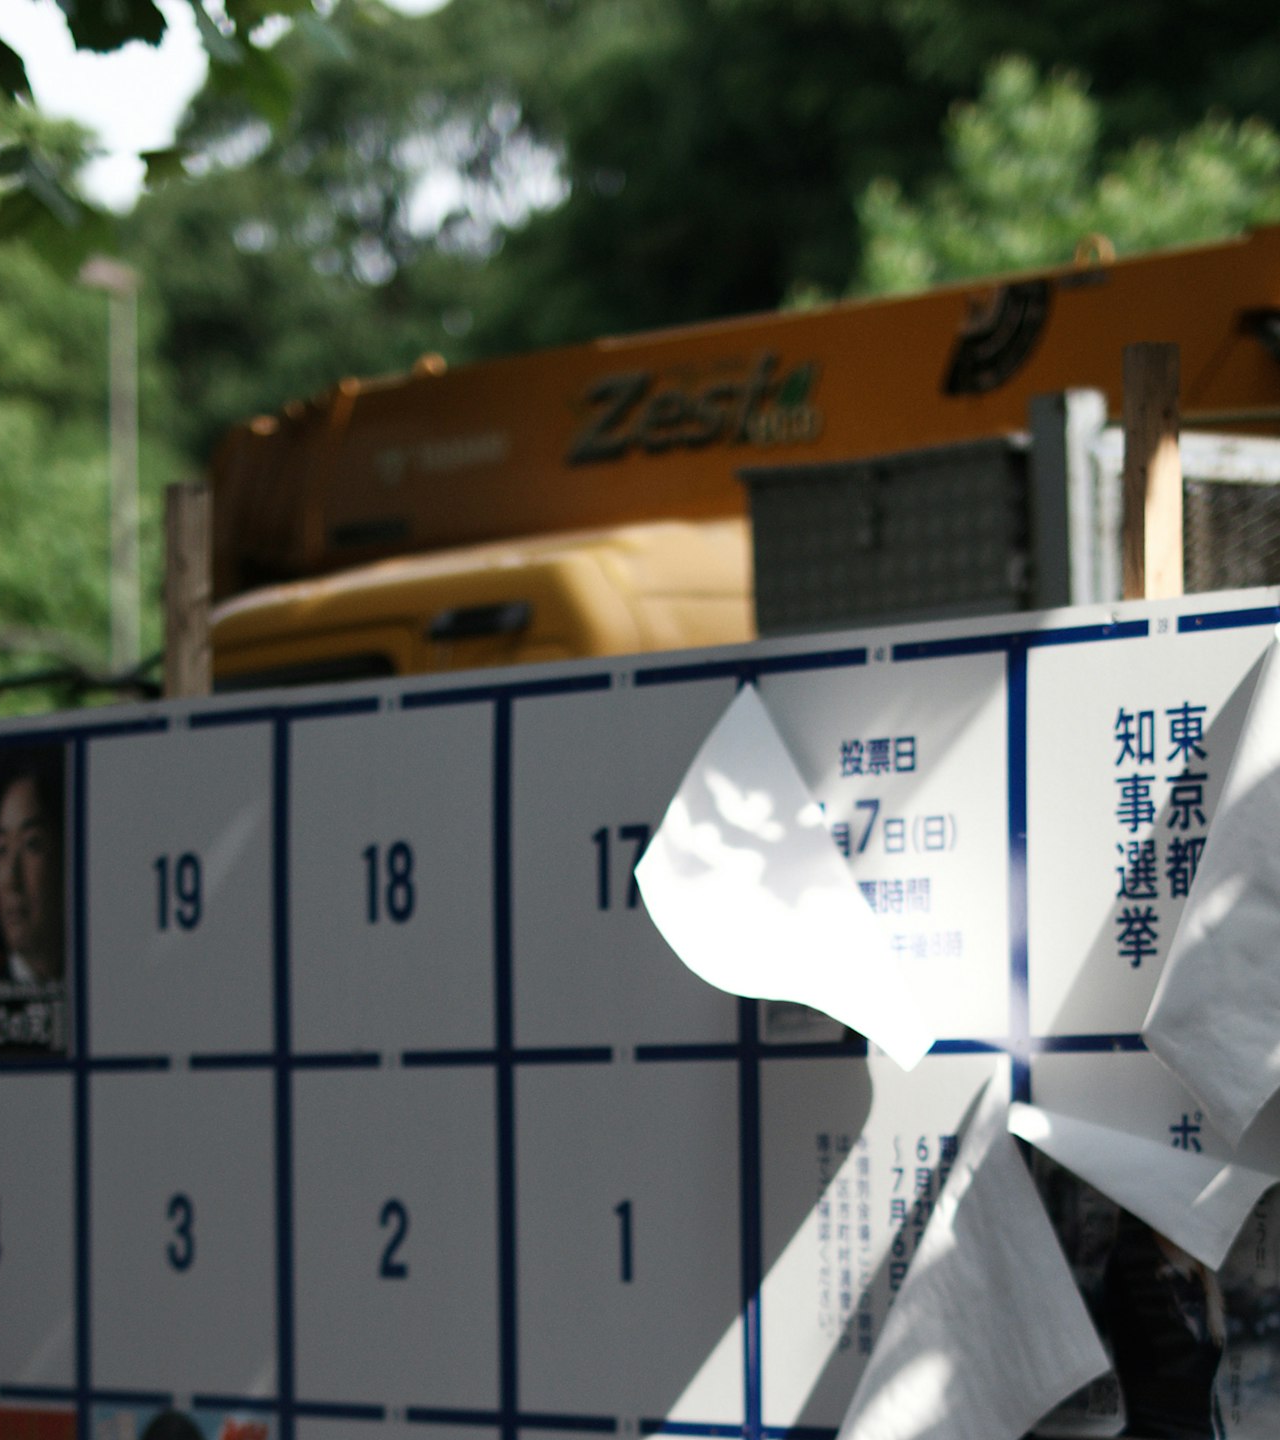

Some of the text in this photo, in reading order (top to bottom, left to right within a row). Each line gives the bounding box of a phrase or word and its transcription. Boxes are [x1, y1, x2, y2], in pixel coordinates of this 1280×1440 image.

[840, 735, 916, 777] 投票日
[1115, 707, 1159, 968] 知事選挙
[1165, 701, 1208, 899] 東京都
[152, 853, 204, 932] 19
[361, 842, 415, 924] 18
[592, 824, 651, 912] 17
[166, 1194, 196, 1273] 3
[378, 1198, 410, 1280] 2
[614, 1200, 633, 1283] 1
